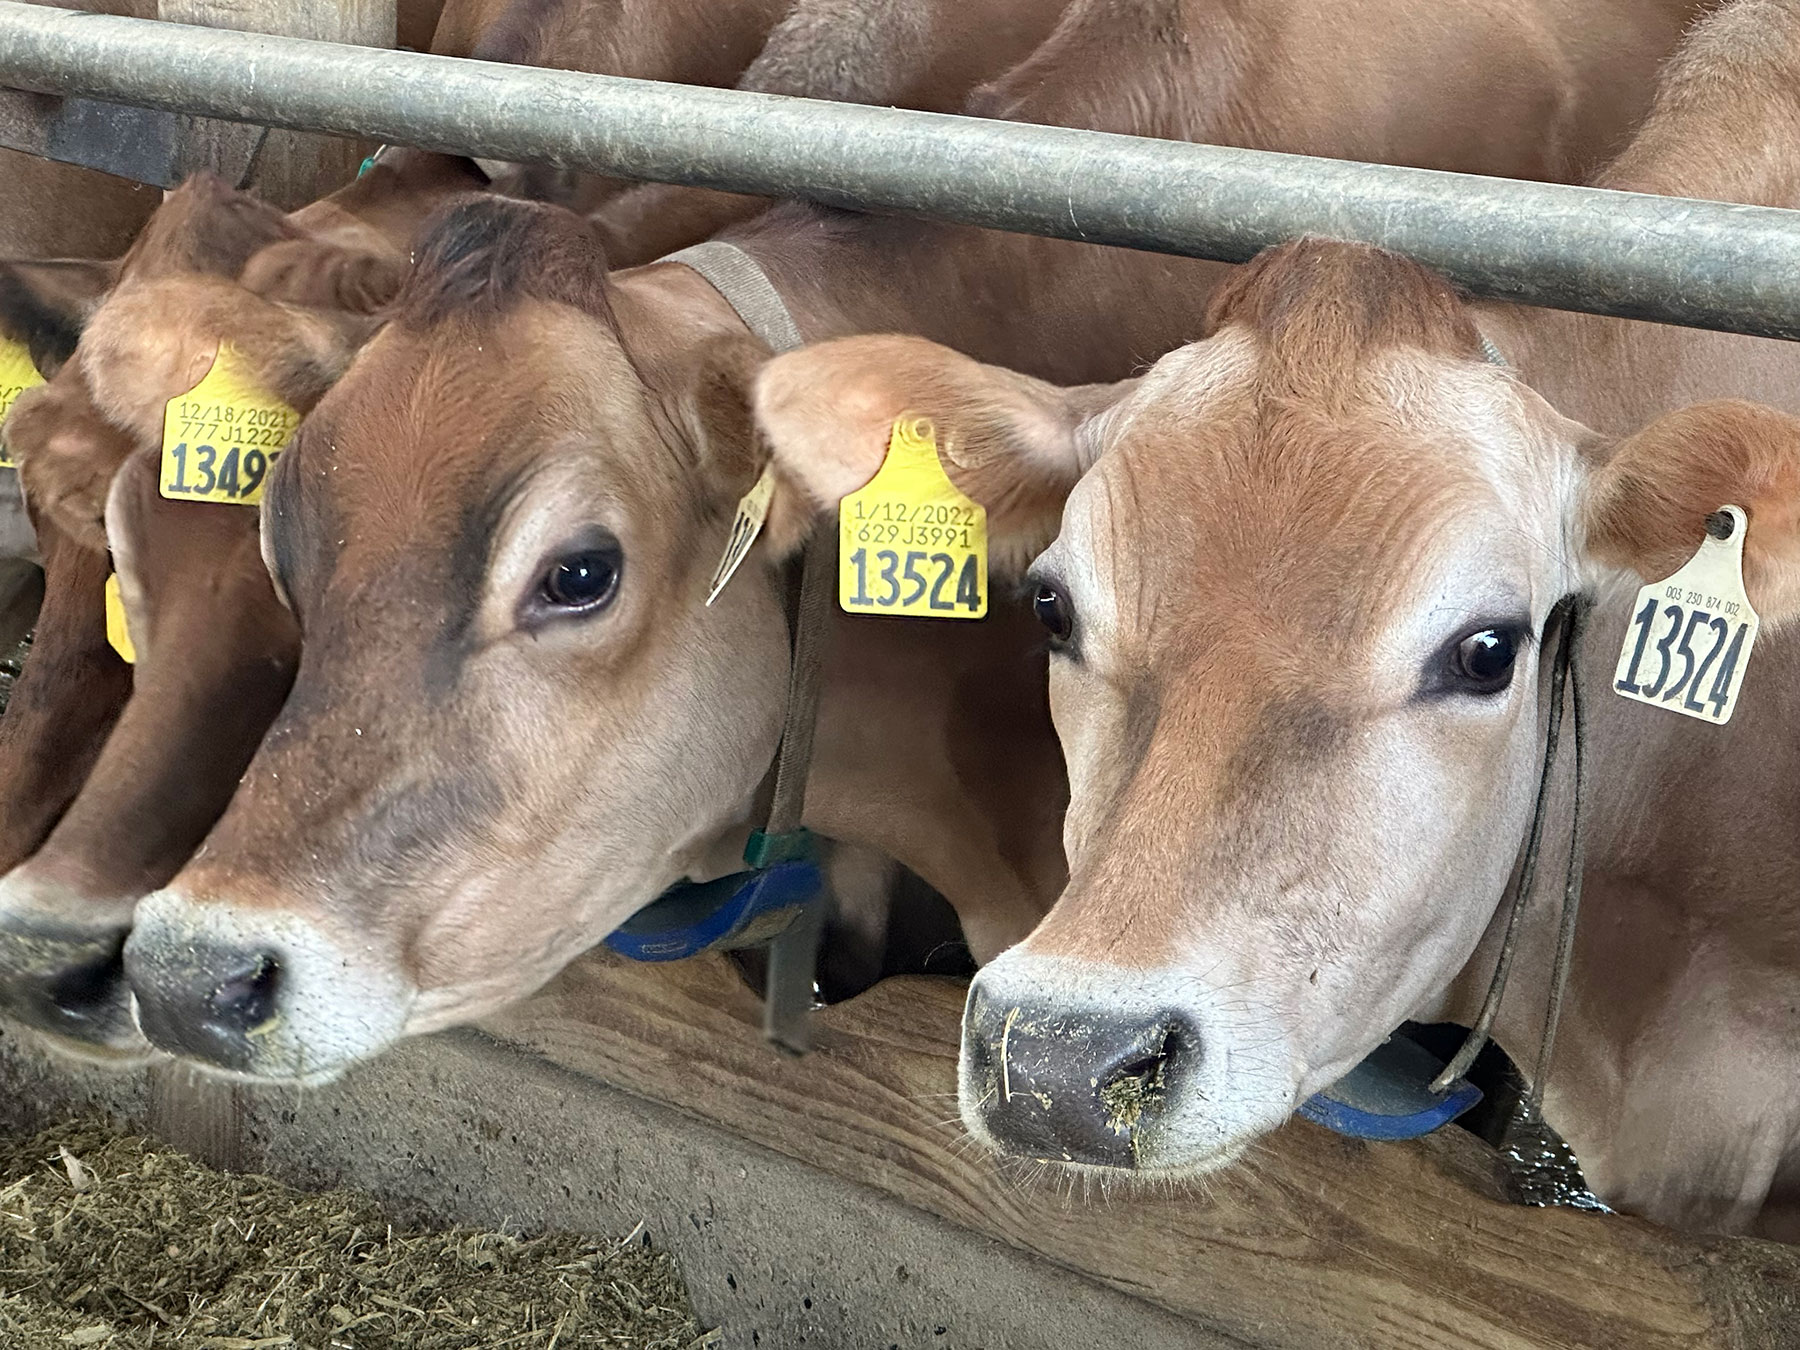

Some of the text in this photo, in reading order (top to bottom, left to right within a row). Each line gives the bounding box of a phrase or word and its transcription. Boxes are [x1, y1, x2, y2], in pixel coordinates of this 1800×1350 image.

[180, 402, 288, 429] 12/18/2021
[180, 421, 286, 447] 777J1222
[168, 443, 281, 498] 1349
[855, 501, 975, 527] 1/12/2022
[858, 523, 972, 548] 629J3991
[850, 548, 982, 612] 13524
[1666, 586, 1741, 617] 003 230 874 002
[1615, 598, 1749, 718] 13524
